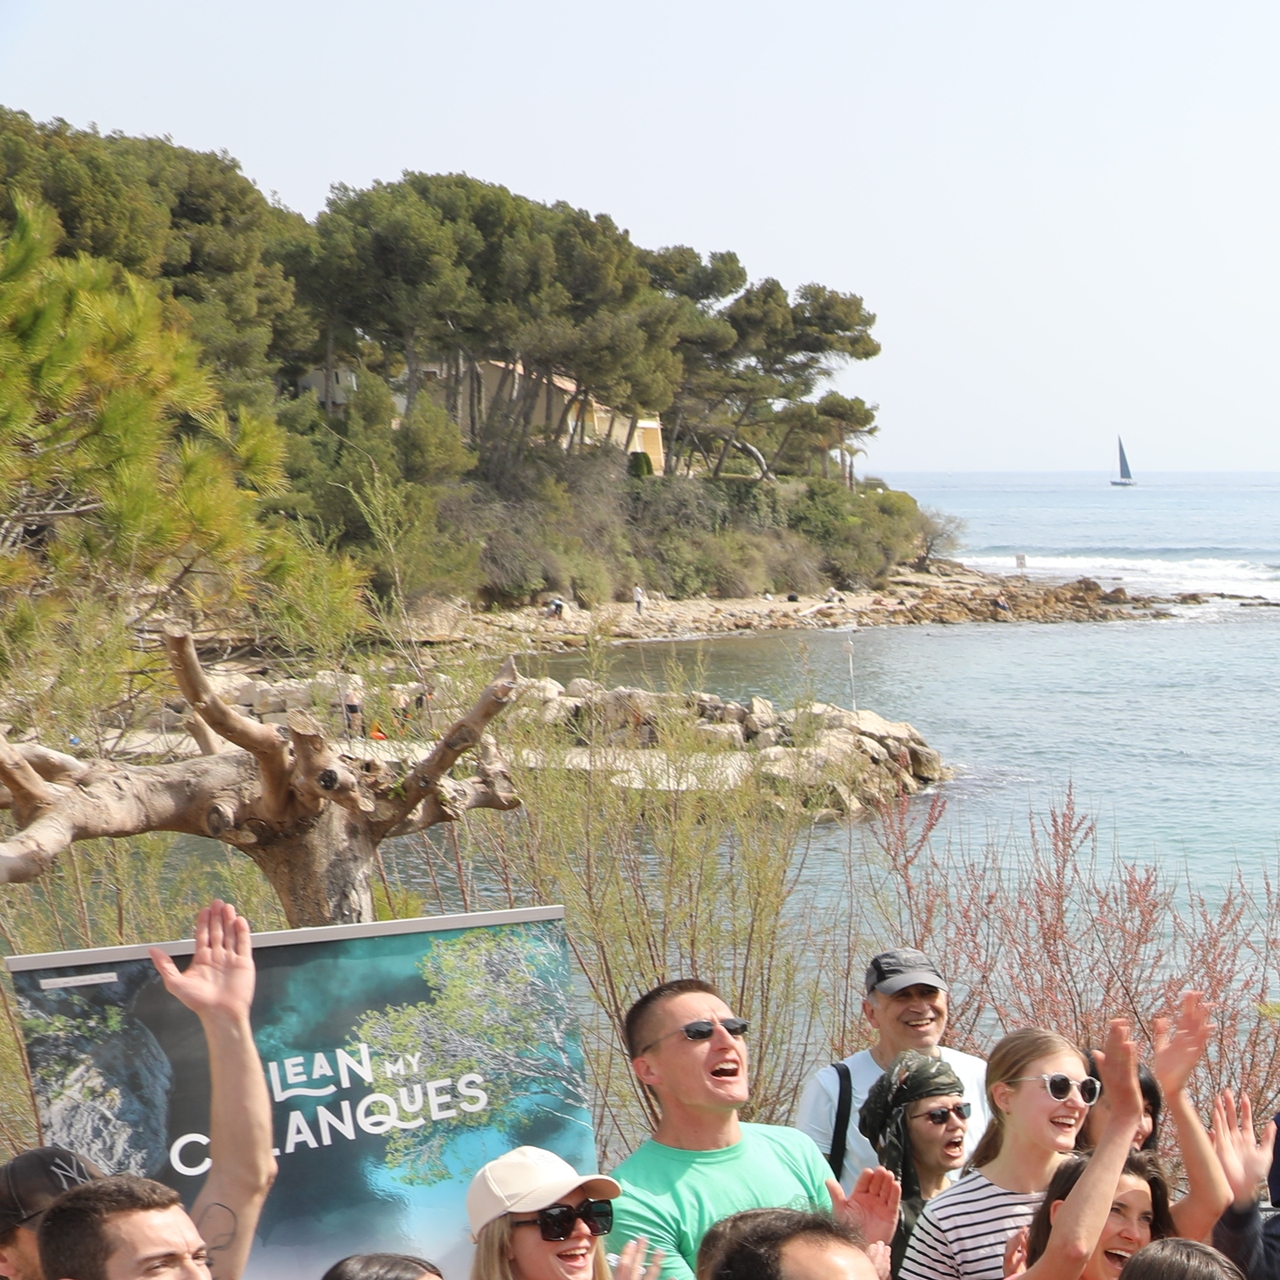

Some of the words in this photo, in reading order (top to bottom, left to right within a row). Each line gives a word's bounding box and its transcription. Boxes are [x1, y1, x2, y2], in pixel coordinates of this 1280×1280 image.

[268, 1043, 374, 1103] LEAN
[384, 1051, 422, 1079] MY
[169, 1073, 489, 1177] CANQUES
